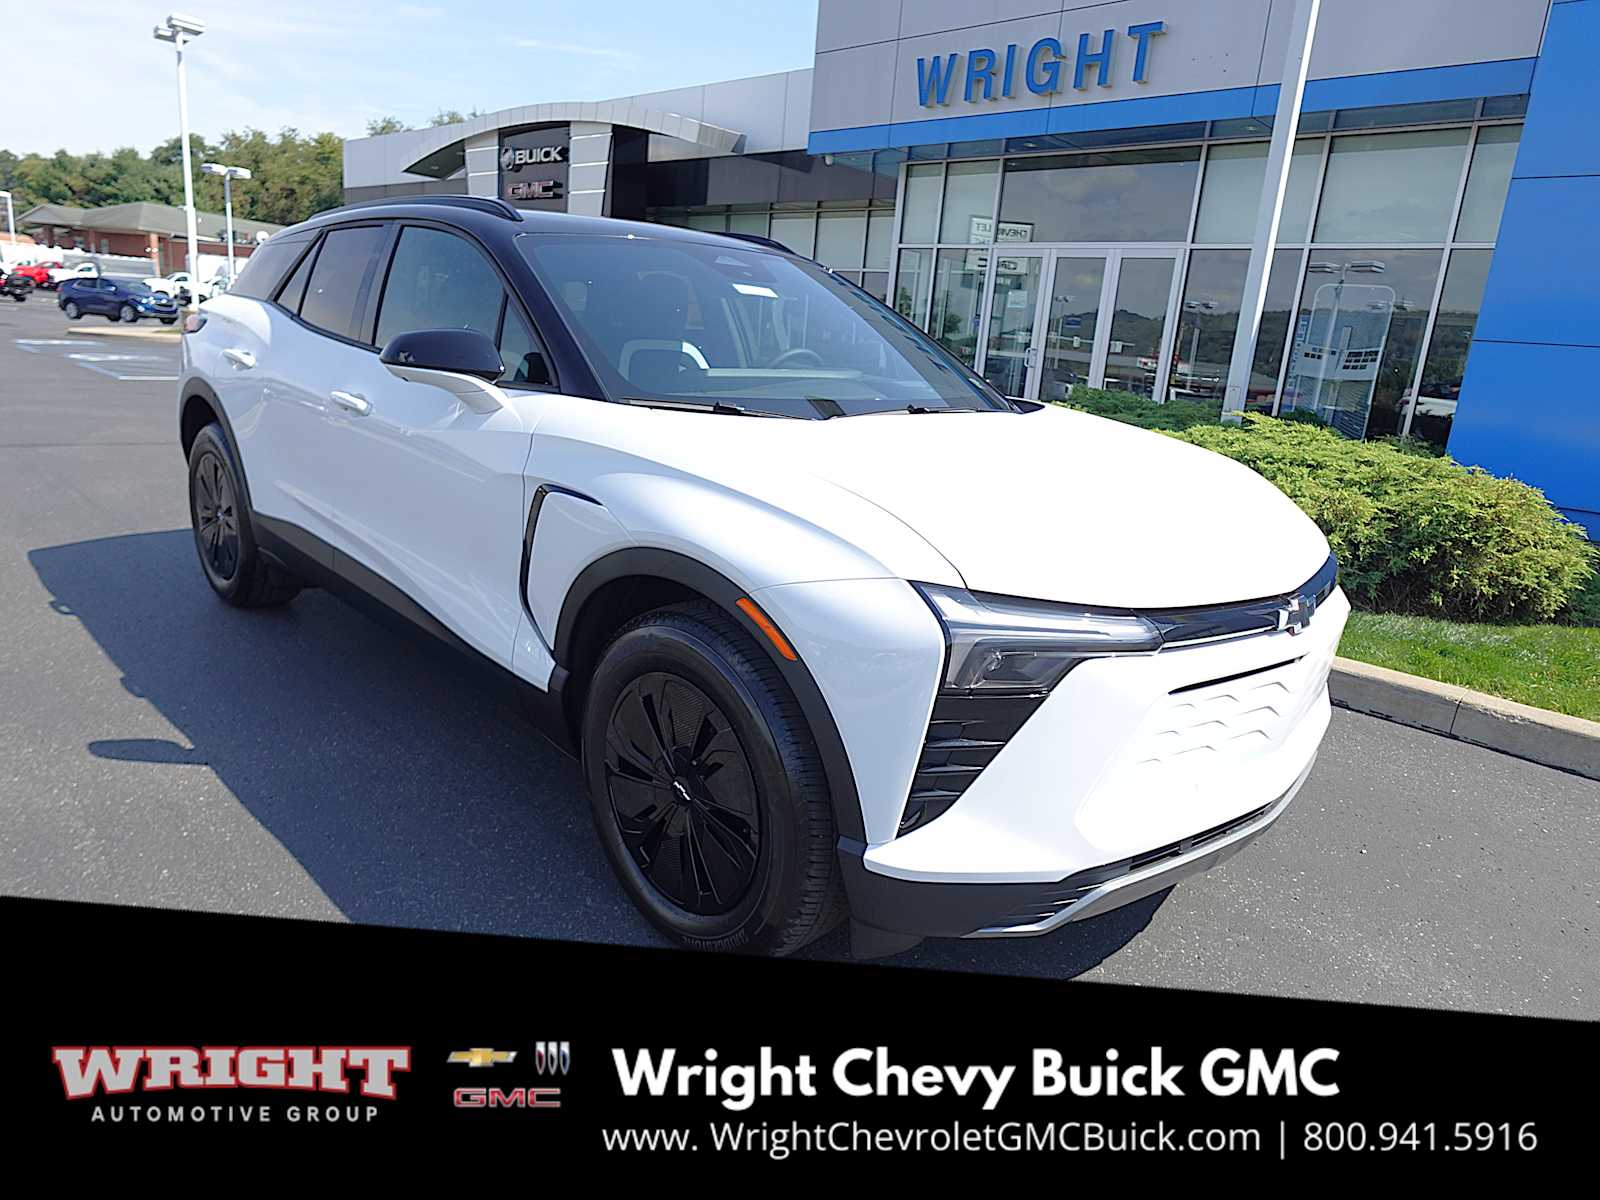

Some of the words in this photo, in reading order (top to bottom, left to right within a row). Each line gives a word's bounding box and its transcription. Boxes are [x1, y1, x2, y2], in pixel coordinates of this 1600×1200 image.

[917, 21, 1167, 108] WRIGHT
[515, 146, 563, 164] BUICK
[508, 180, 554, 199] GMC
